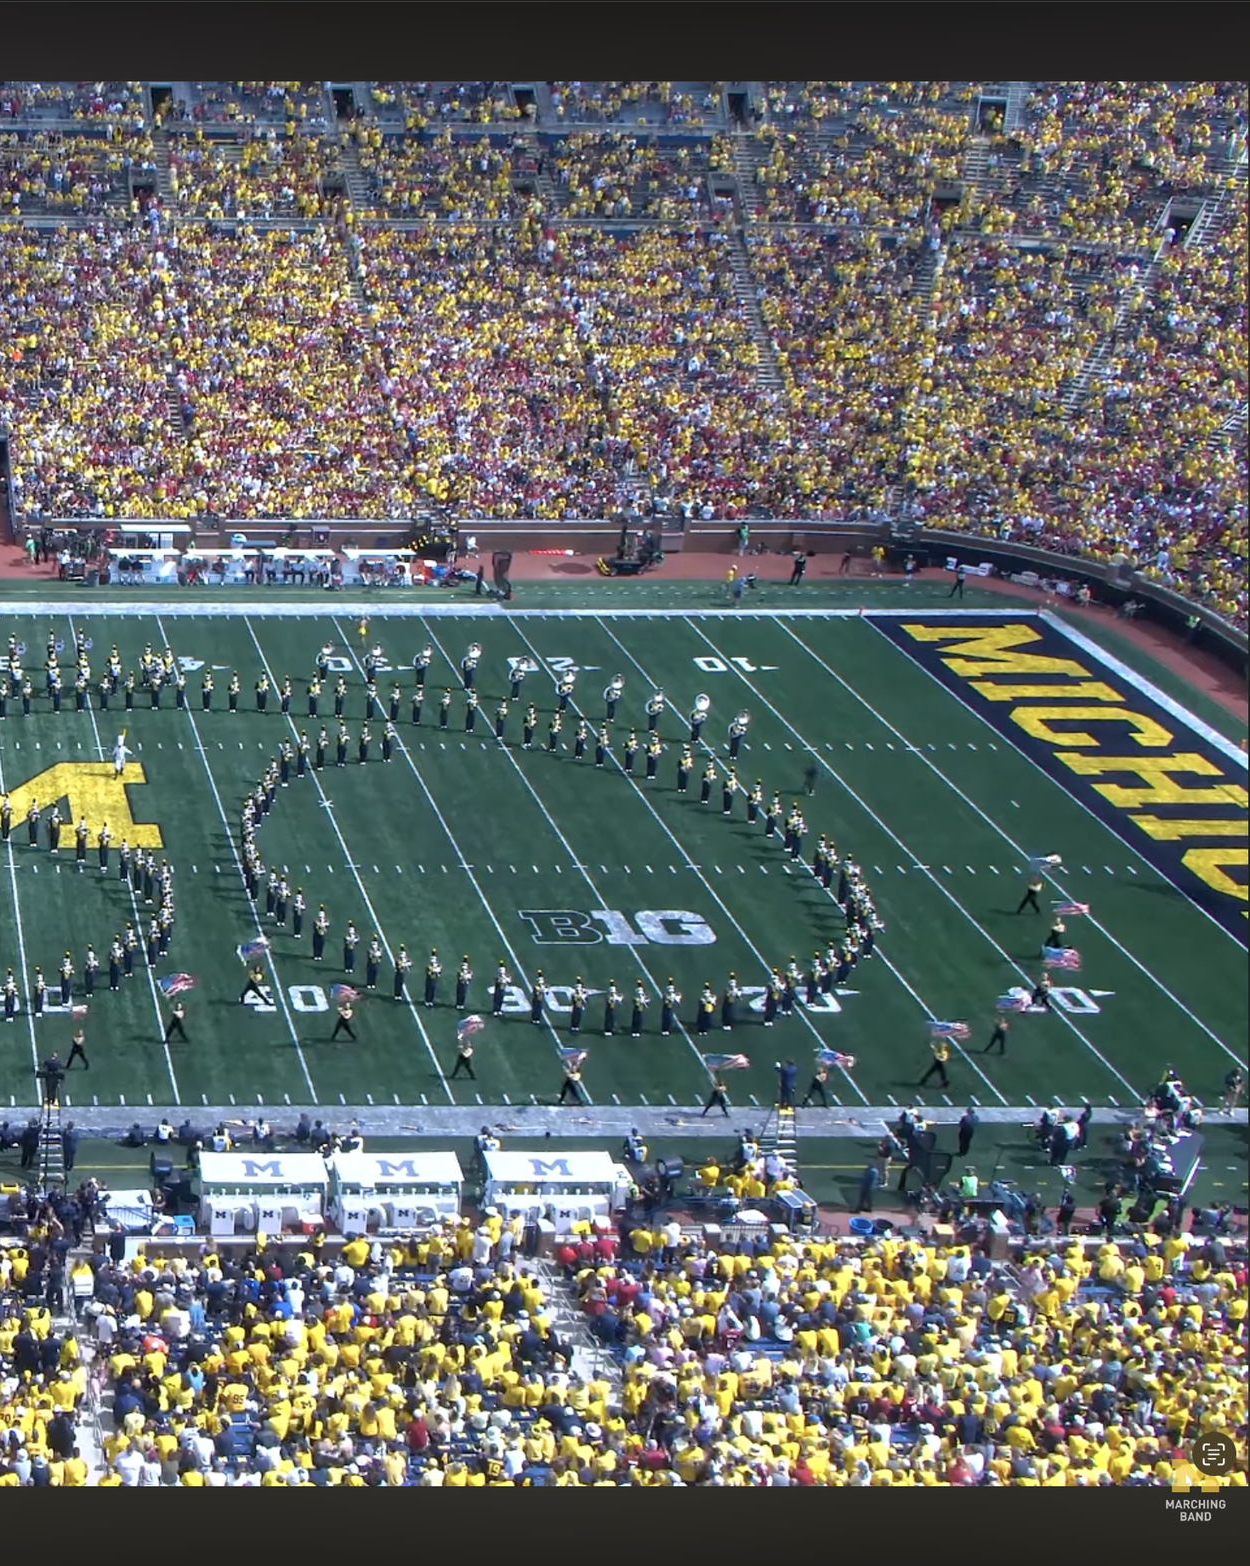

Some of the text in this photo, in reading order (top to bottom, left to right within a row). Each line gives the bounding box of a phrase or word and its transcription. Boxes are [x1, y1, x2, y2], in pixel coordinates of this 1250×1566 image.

[693, 656, 760, 672] 10
[241, 1160, 284, 1177] M
[376, 1160, 419, 1177] M
[528, 1158, 573, 1176] M
[215, 1210, 227, 1219] M
[262, 1210, 274, 1218] M
[347, 1211, 359, 1220] M
[398, 1209, 409, 1217] M
[559, 1210, 571, 1219] M
[488, 1462, 499, 1476] 19
